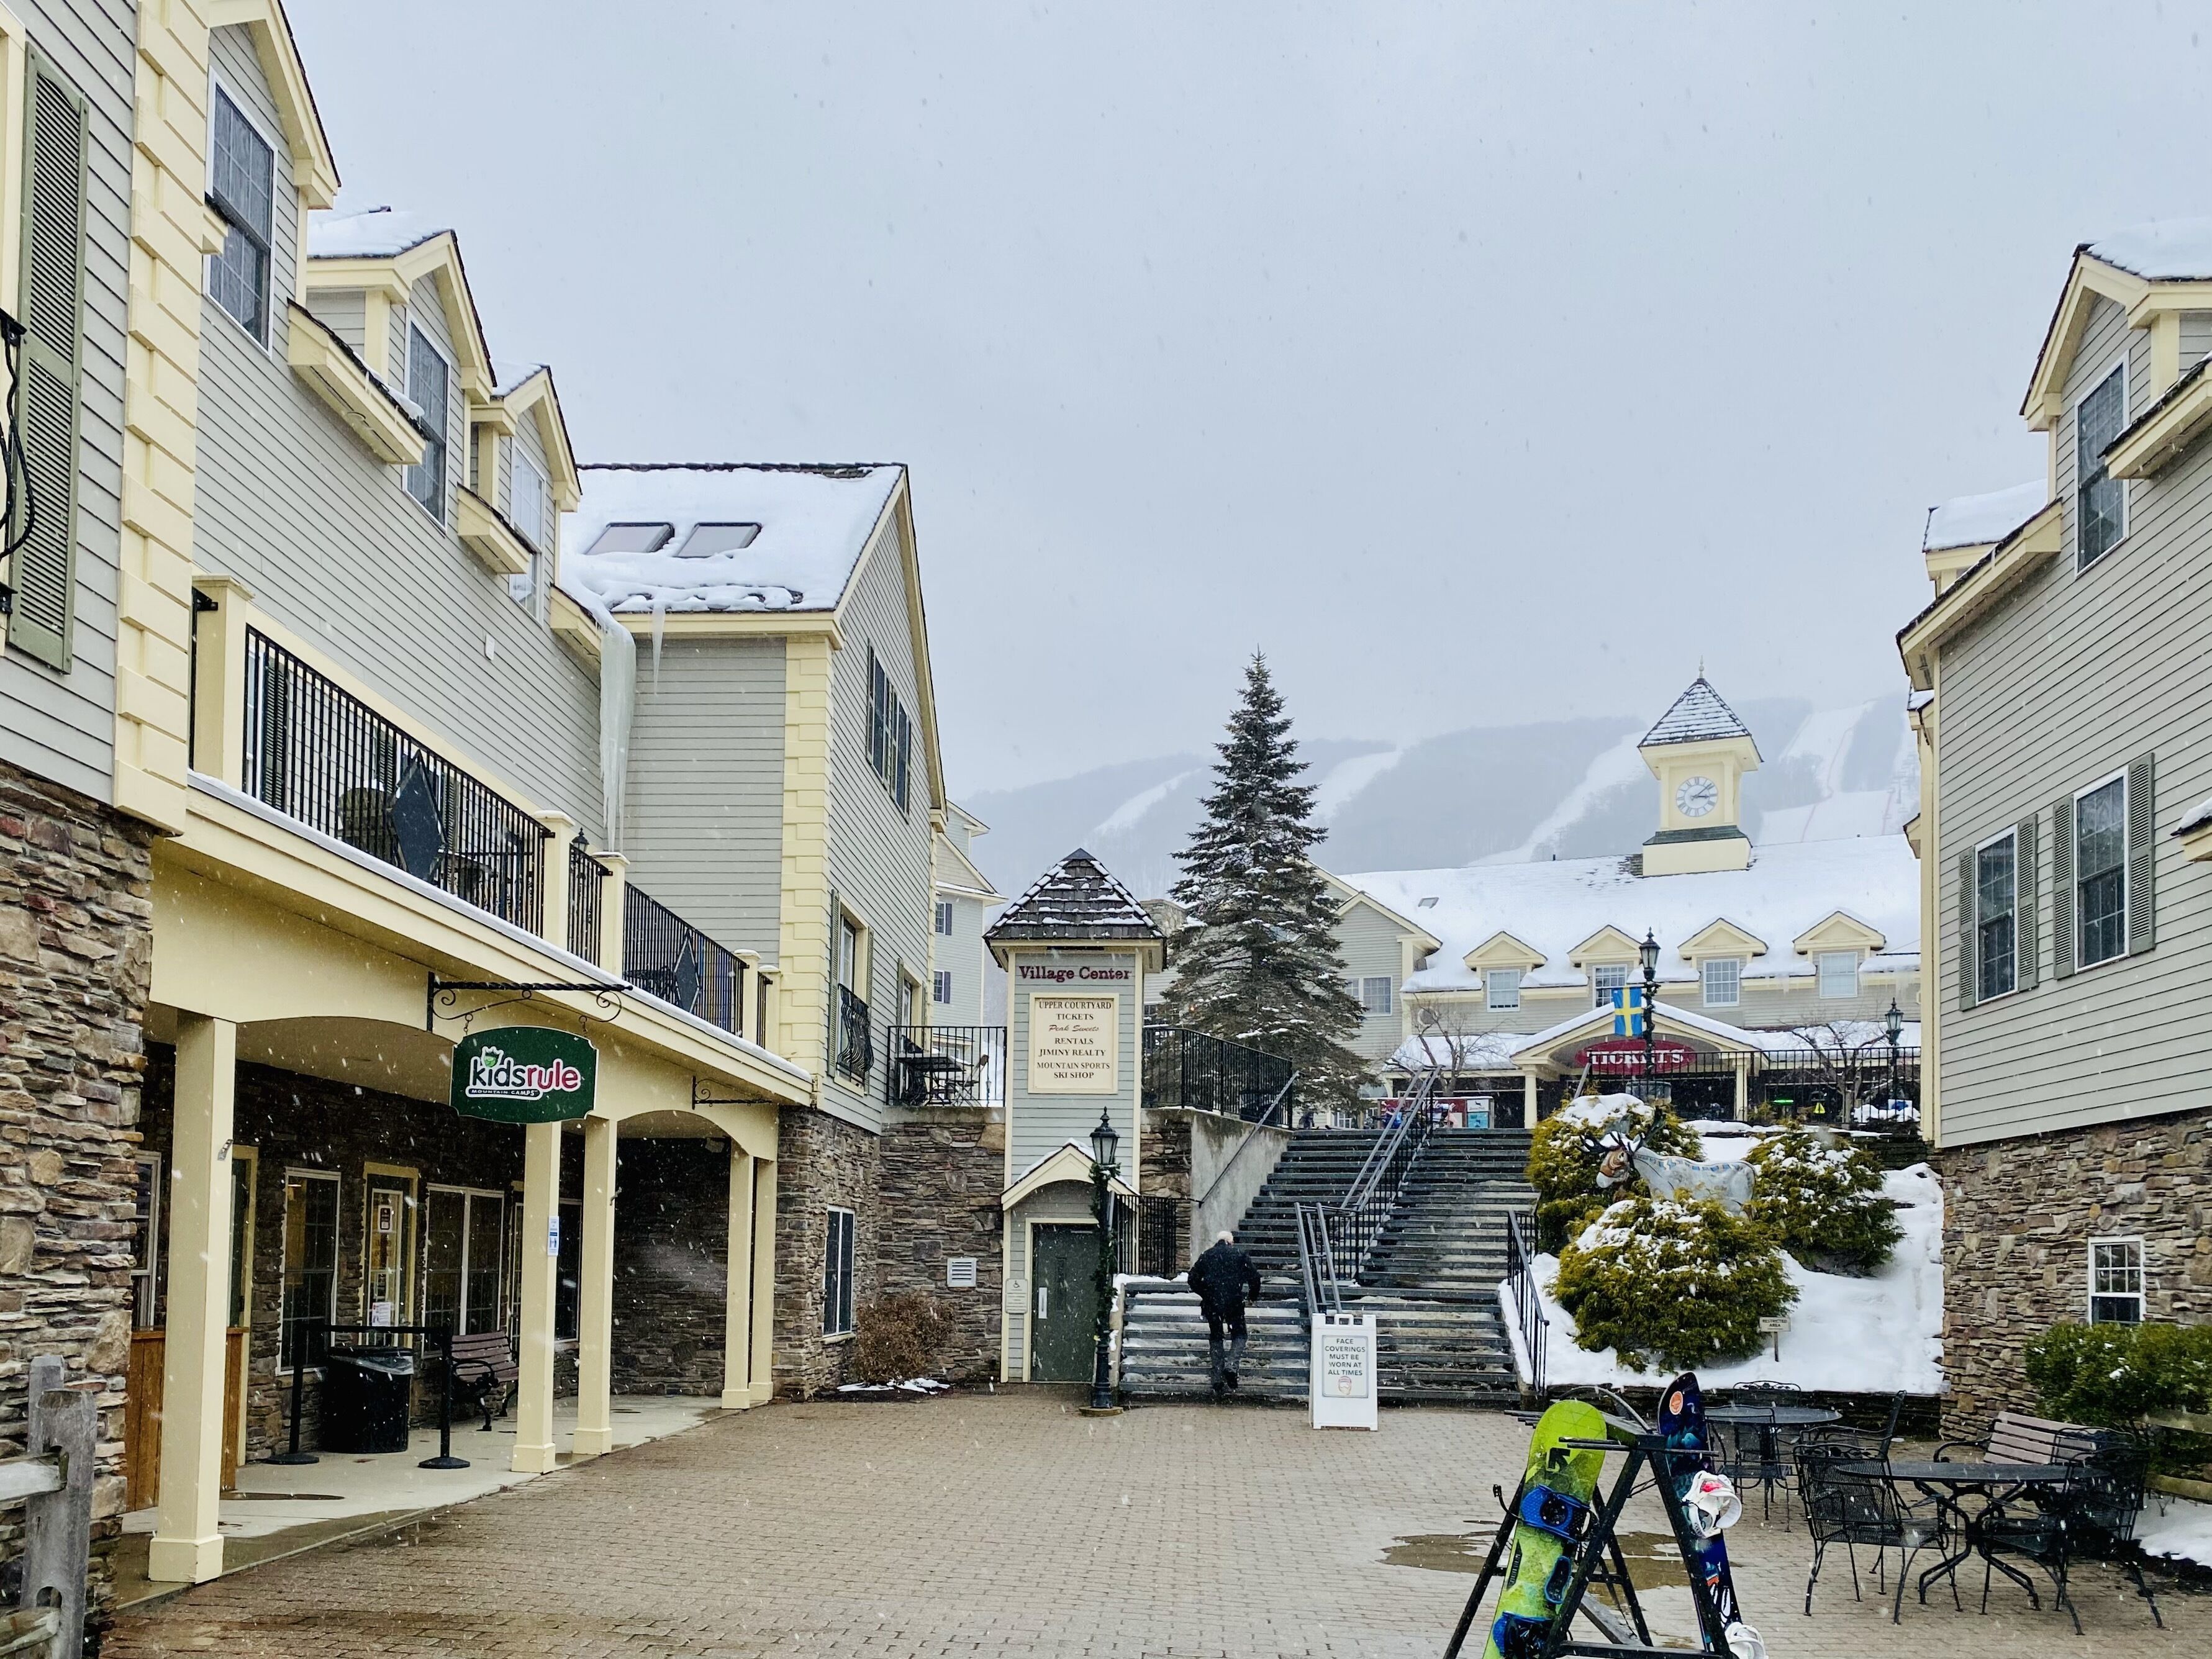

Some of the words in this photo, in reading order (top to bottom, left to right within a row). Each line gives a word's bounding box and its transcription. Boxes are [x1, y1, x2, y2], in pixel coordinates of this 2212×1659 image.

[1018, 965, 1074, 982] Village
[1079, 966, 1132, 979] Center
[1039, 1001, 1063, 1010] UPPER
[1064, 1001, 1112, 1010] COURTYARD
